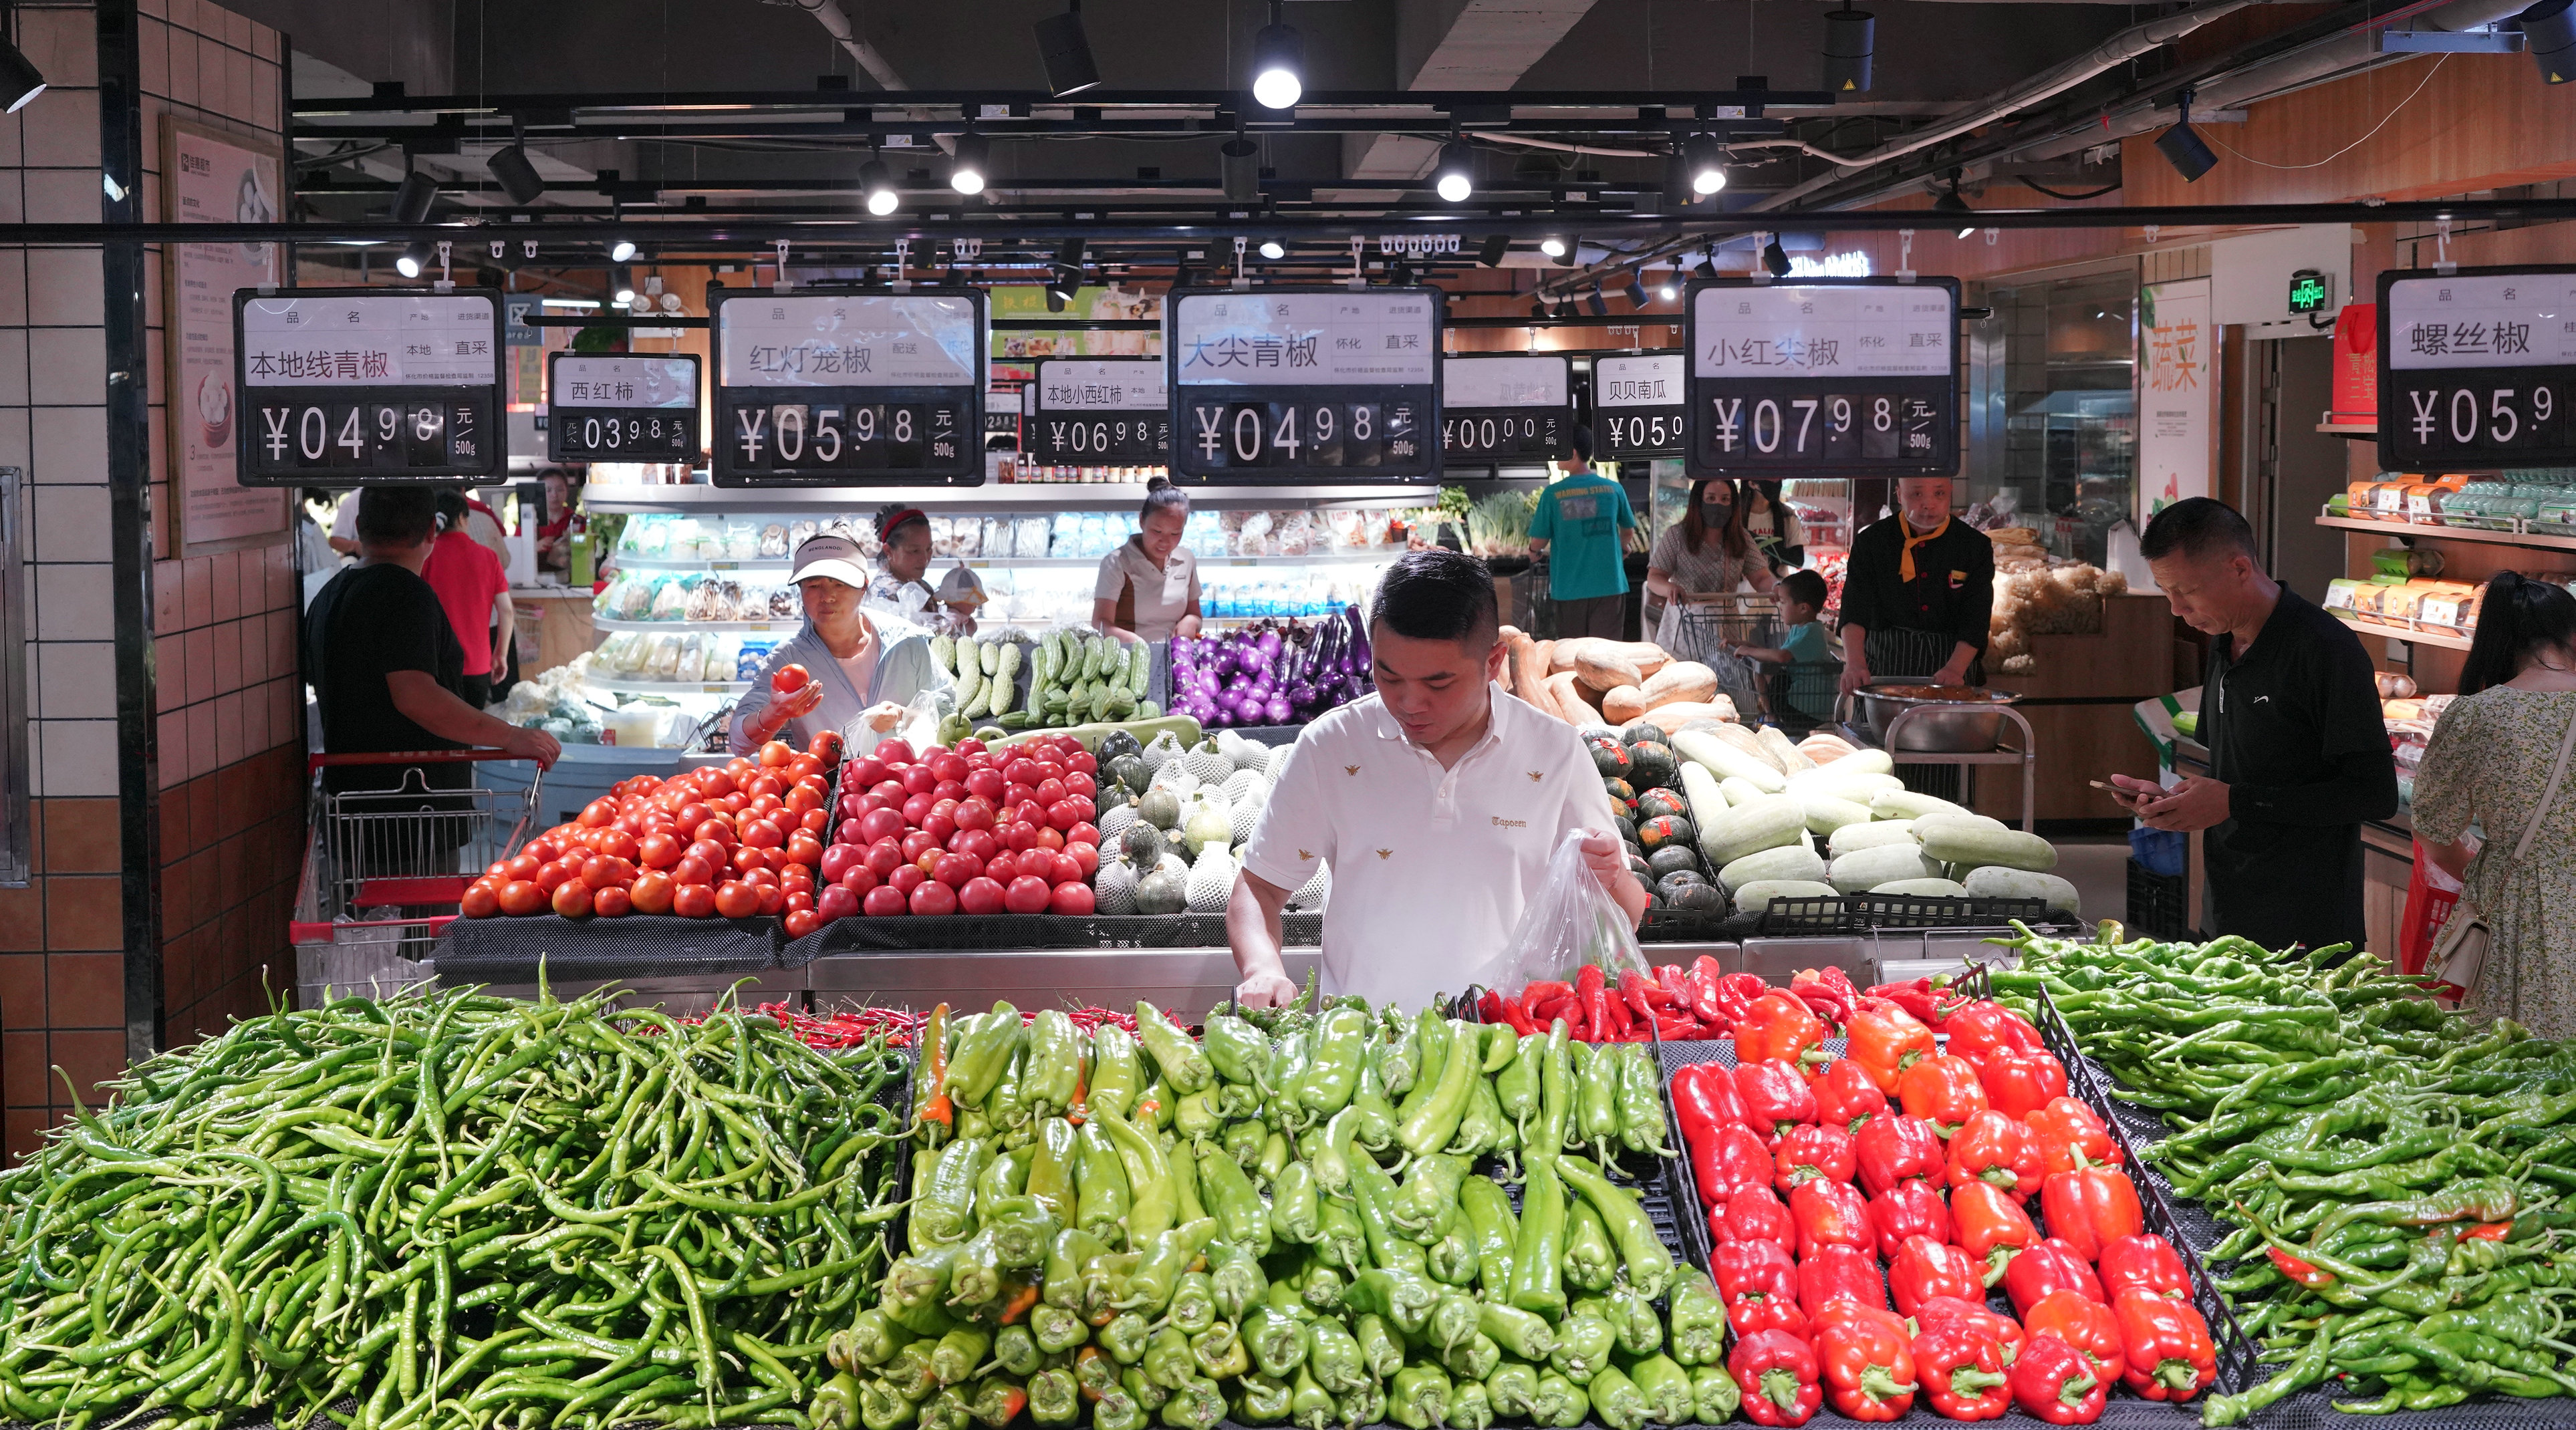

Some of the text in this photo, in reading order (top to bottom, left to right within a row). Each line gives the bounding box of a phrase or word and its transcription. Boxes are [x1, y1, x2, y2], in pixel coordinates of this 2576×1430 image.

[458, 313, 489, 321] 进货渠道
[406, 344, 432, 355] 本地
[455, 341, 487, 355] 直采
[893, 343, 917, 353] 配送
[1184, 334, 1317, 368] 大尖青椒
[1336, 338, 1362, 349] 怀化
[1386, 334, 1418, 349] 直采
[1708, 338, 1839, 367] 小红尖椒
[1859, 336, 1885, 347] 怀化
[1909, 333, 1942, 347] 直采
[2410, 321, 2530, 355] 螺丝椒
[250, 349, 388, 380] 本地线青椒
[749, 345, 872, 374] 红灯笼椒
[2152, 317, 2198, 393] 蔬菜
[571, 382, 634, 401] 西红柿
[1047, 384, 1122, 405] 本地小西红柿
[1609, 380, 1667, 400] 贝贝南瓜
[262, 406, 433, 460] ¥04.98
[585, 418, 661, 448] 03.98
[738, 408, 912, 462] ¥05.98
[1050, 422, 1147, 452] ¥06.98
[1196, 406, 1372, 461] ¥04.98
[1714, 398, 1891, 452] ¥07.98
